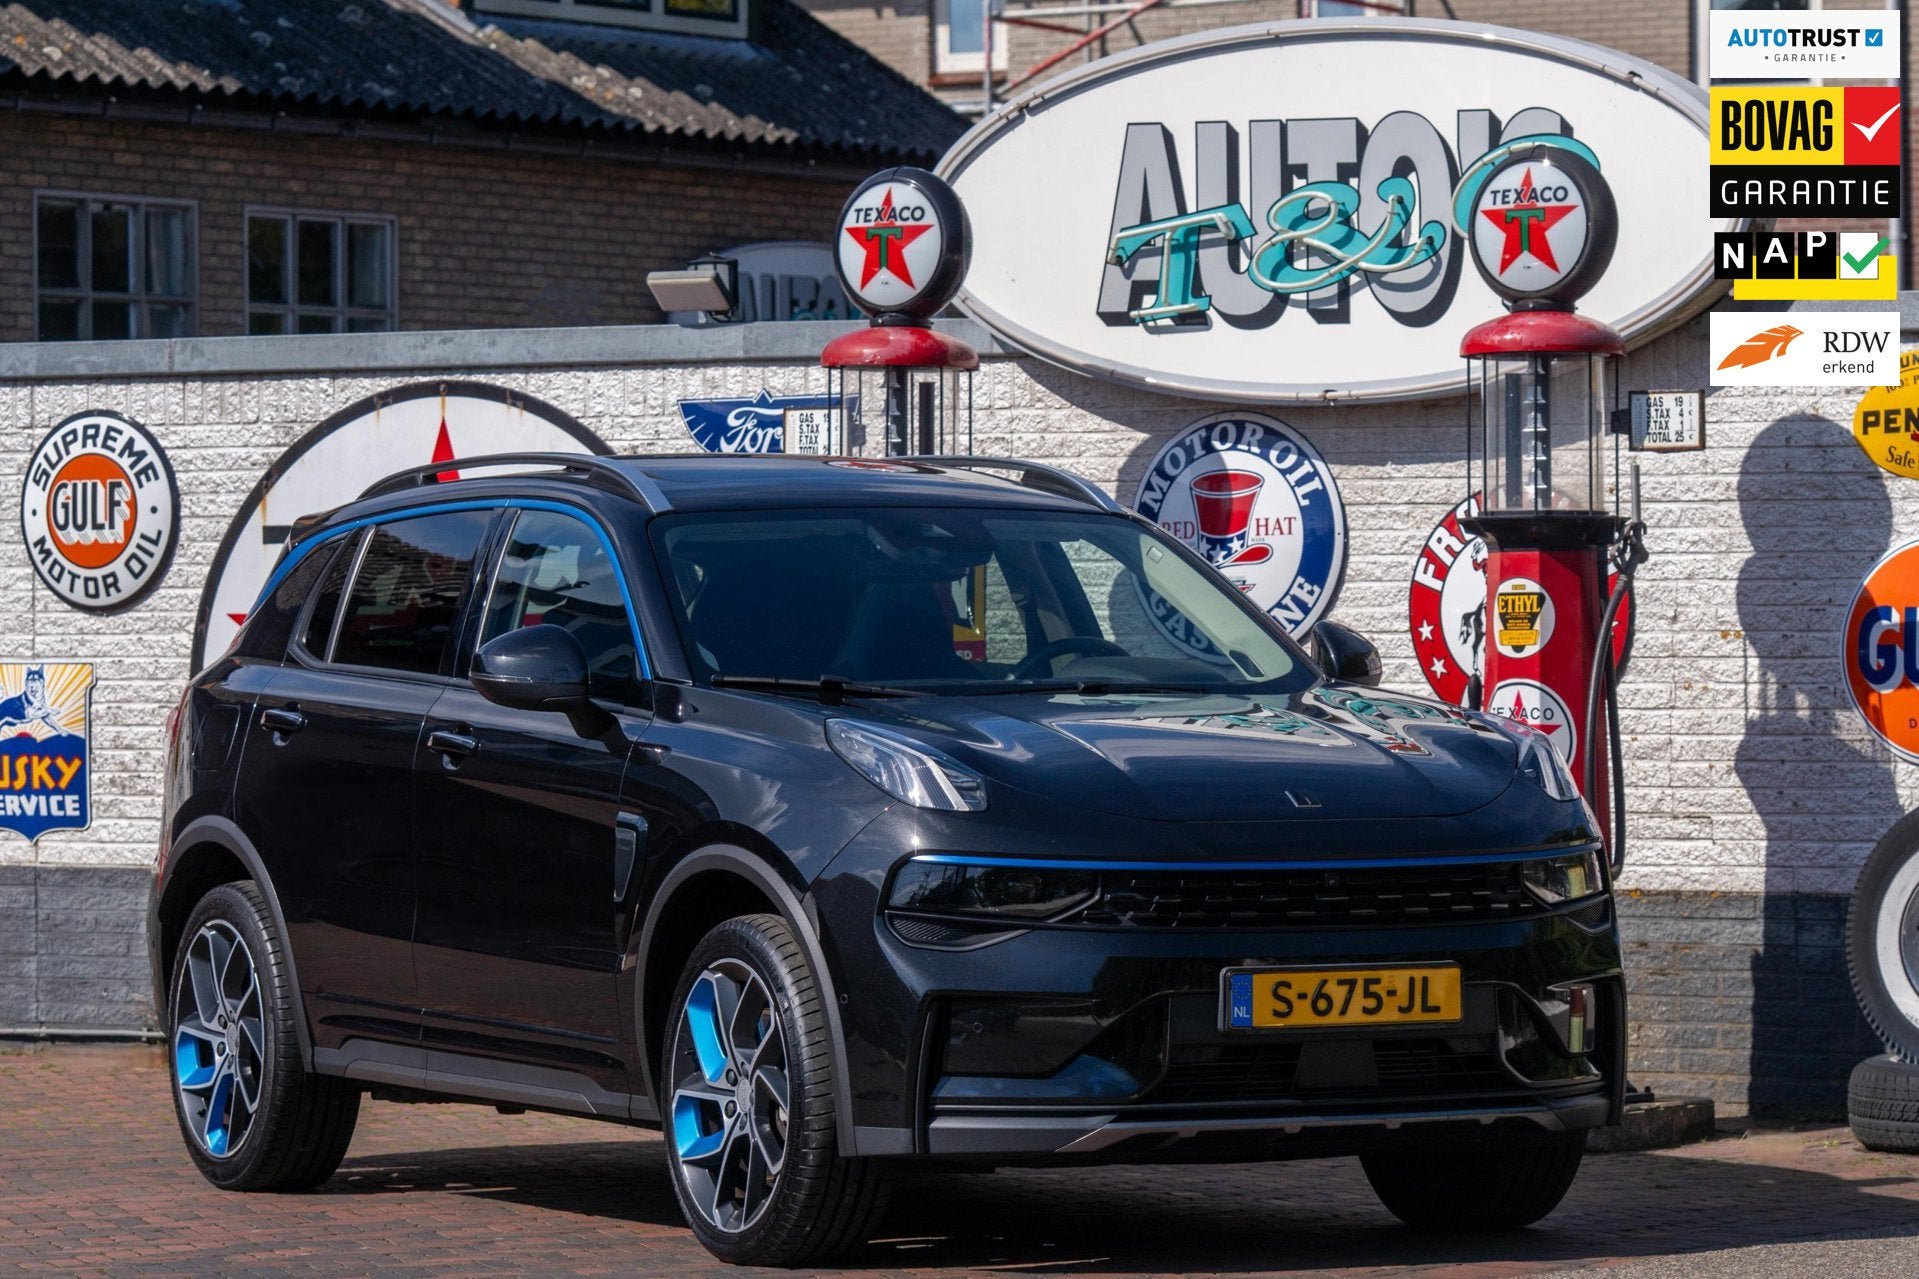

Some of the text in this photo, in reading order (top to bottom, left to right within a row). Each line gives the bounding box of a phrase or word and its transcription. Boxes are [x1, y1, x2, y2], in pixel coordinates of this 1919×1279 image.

[1490, 186, 1569, 205] TEXACO
[854, 206, 925, 223] TEXACO
[1646, 396, 1664, 407] GAS
[799, 413, 815, 423] GAS
[1646, 432, 1672, 443] TOTAL
[1674, 432, 1685, 442] 25
[33, 424, 160, 491] SUPREME
[1886, 446, 1915, 468] Safe
[1141, 421, 1323, 514] MOTOR OIL
[52, 480, 129, 542] GULF
[1254, 517, 1297, 536] HAT
[33, 529, 163, 599] MOTOR OIL
[1498, 594, 1541, 613] ETHYL
[1492, 707, 1555, 720] EXACO
[1271, 976, 1441, 1018] S-675-JL
[1234, 1006, 1250, 1018] NL
